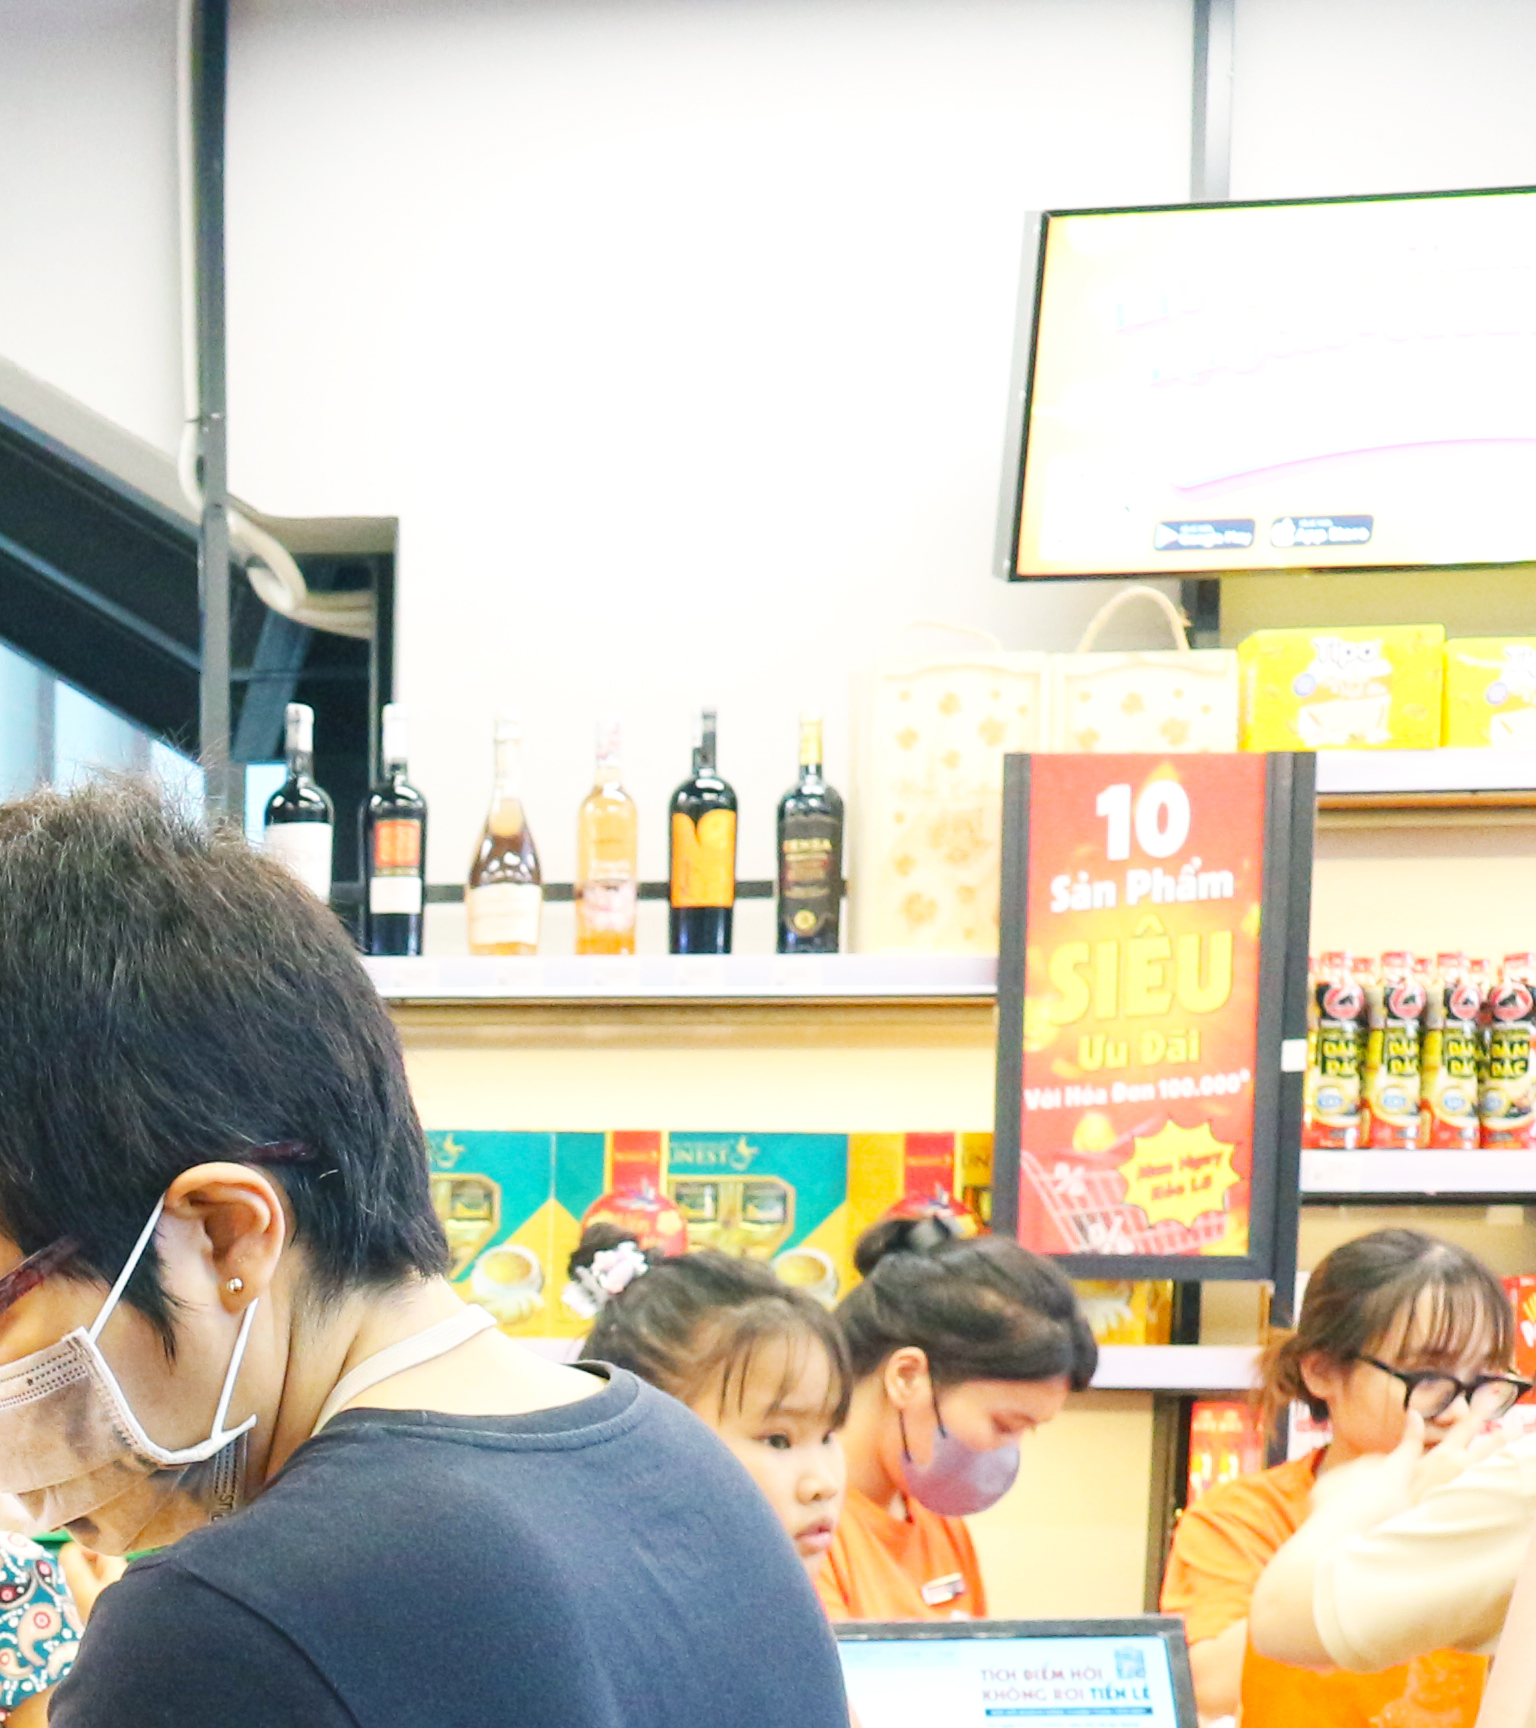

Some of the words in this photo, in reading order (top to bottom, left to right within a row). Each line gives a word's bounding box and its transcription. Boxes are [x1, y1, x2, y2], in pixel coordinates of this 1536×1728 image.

[1096, 779, 1190, 860] 10
[1050, 870, 1117, 912] Sản
[1127, 857, 1234, 907] Phẩm
[1048, 914, 1234, 1026] SIÊU
[1078, 1033, 1129, 1071] Ưu
[1141, 1029, 1201, 1066] Đãi
[983, 1685, 1046, 1701] KHÔNG
